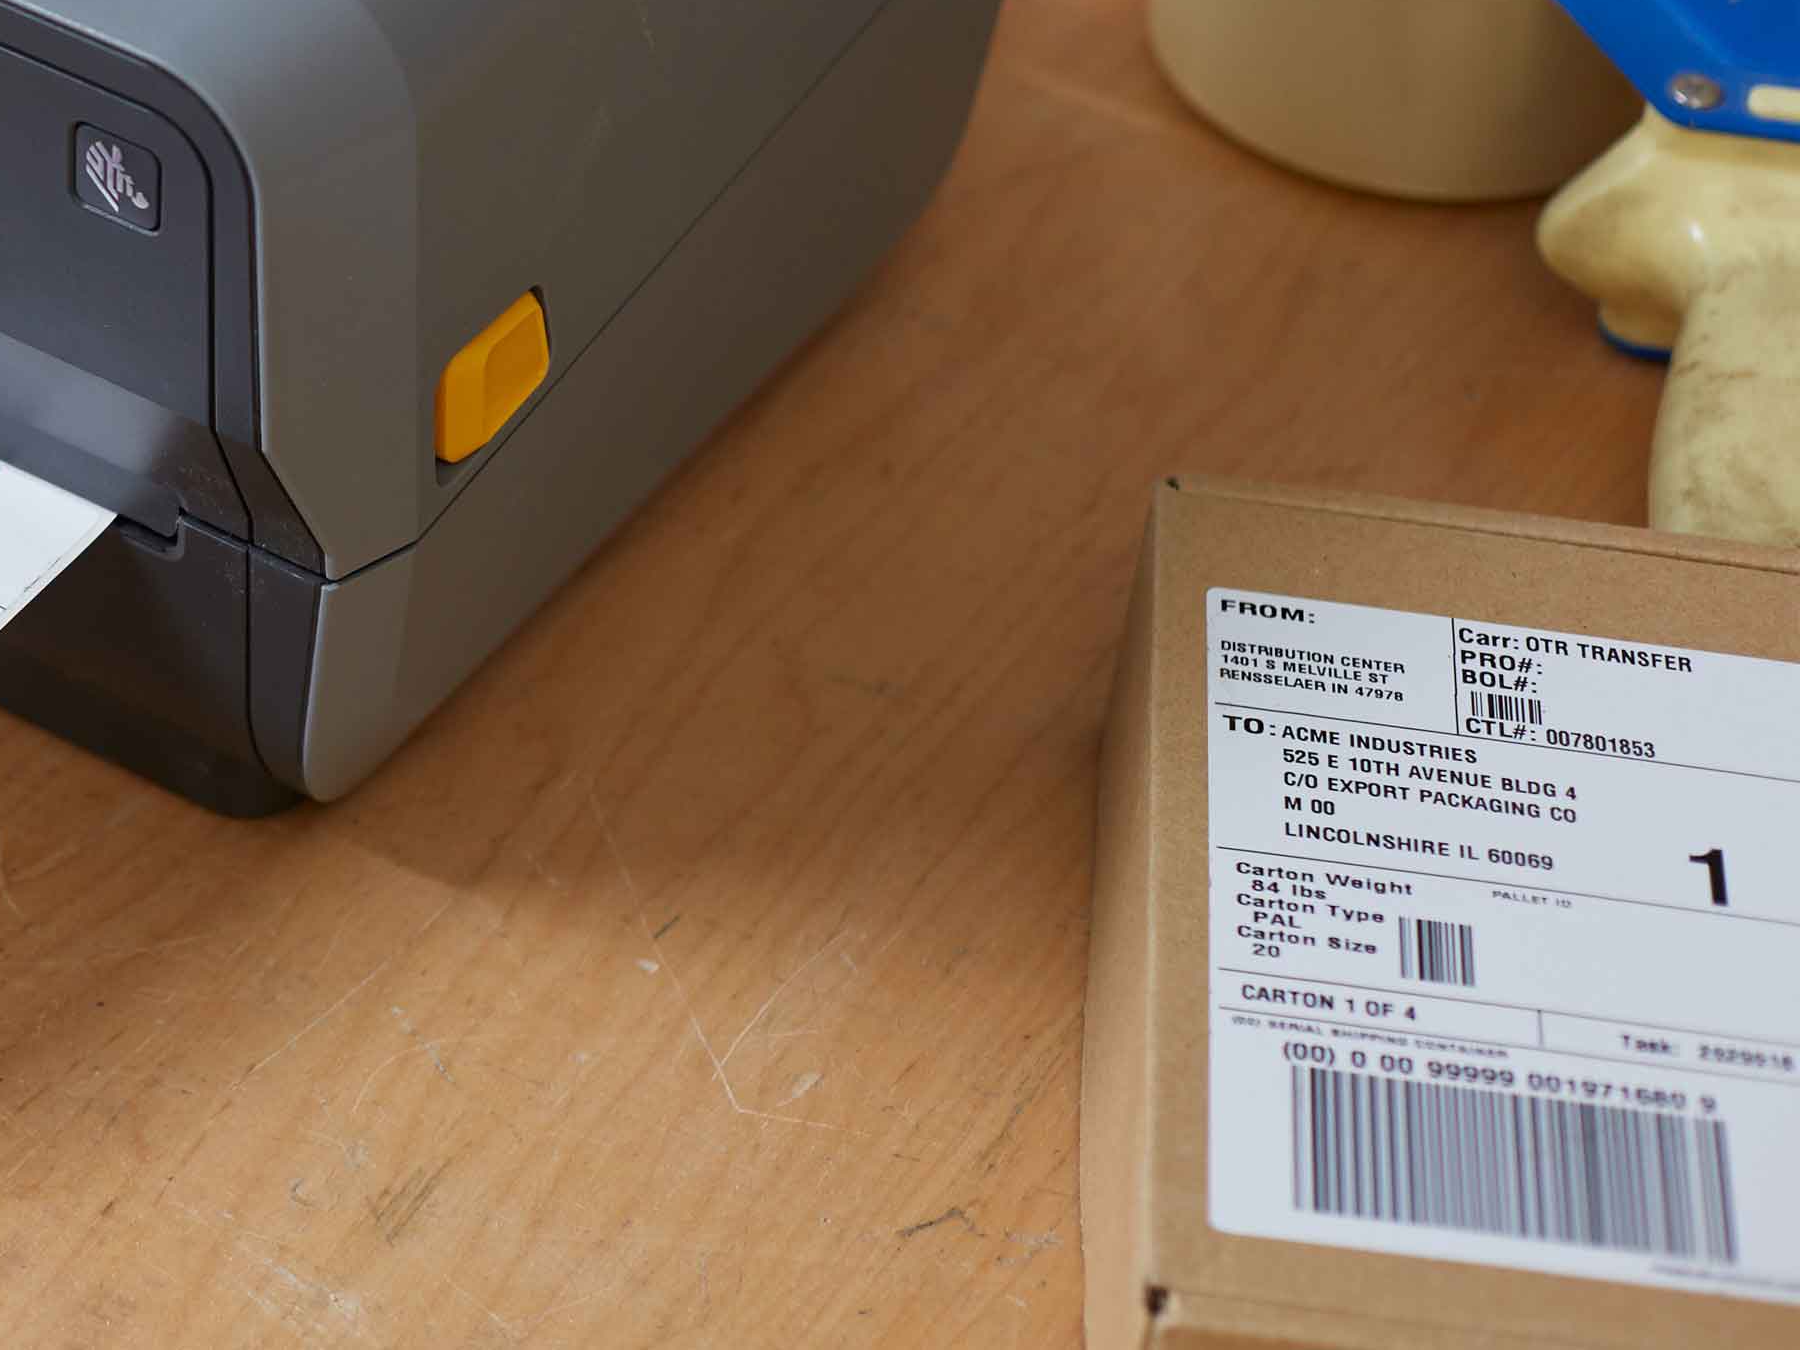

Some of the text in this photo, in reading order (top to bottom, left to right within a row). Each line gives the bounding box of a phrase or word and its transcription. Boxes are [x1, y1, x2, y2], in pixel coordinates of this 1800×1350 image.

[1220, 599, 1315, 624] FROM:
[1220, 640, 1405, 674] DISTRIBUTION CENTER
[1458, 628, 1692, 673] Carr: OTR TRANSFER
[1460, 650, 1543, 675] PRO#:
[1220, 668, 1404, 702] RENSSELAER IN 47978
[1222, 654, 1389, 685] 1401 S MELVILLE ST
[1462, 669, 1537, 694] BOL#:
[1223, 714, 1477, 763] TO: ACME INDUSTRIES
[1466, 717, 1656, 758] CTL#: 007801853
[1283, 748, 1577, 800] 525 E 10TH AVENUE BLDG 4
[1283, 771, 1577, 823] C/O EXPORT PACKAGING CO
[1284, 796, 1336, 816] M 00
[1285, 822, 1553, 871] LINCOLNSHIRE IL 60069
[1236, 861, 1413, 896] Carton Weight
[1251, 879, 1327, 900] 84 lbs
[1689, 848, 1728, 906] 1
[1236, 893, 1384, 923] Carton Type
[1492, 890, 1548, 906] PALLET
[1253, 911, 1301, 929] PAL
[1237, 925, 1377, 955] Carton Size
[1253, 943, 1281, 958] 20
[1241, 984, 1417, 1021] CARTON 1 OF 4
[1284, 1041, 1336, 1067] (00)
[1351, 1051, 1366, 1068] 0
[1380, 1055, 1413, 1075] 00
[1427, 1060, 1514, 1088] 99999
[1699, 1096, 1717, 1114] 9
